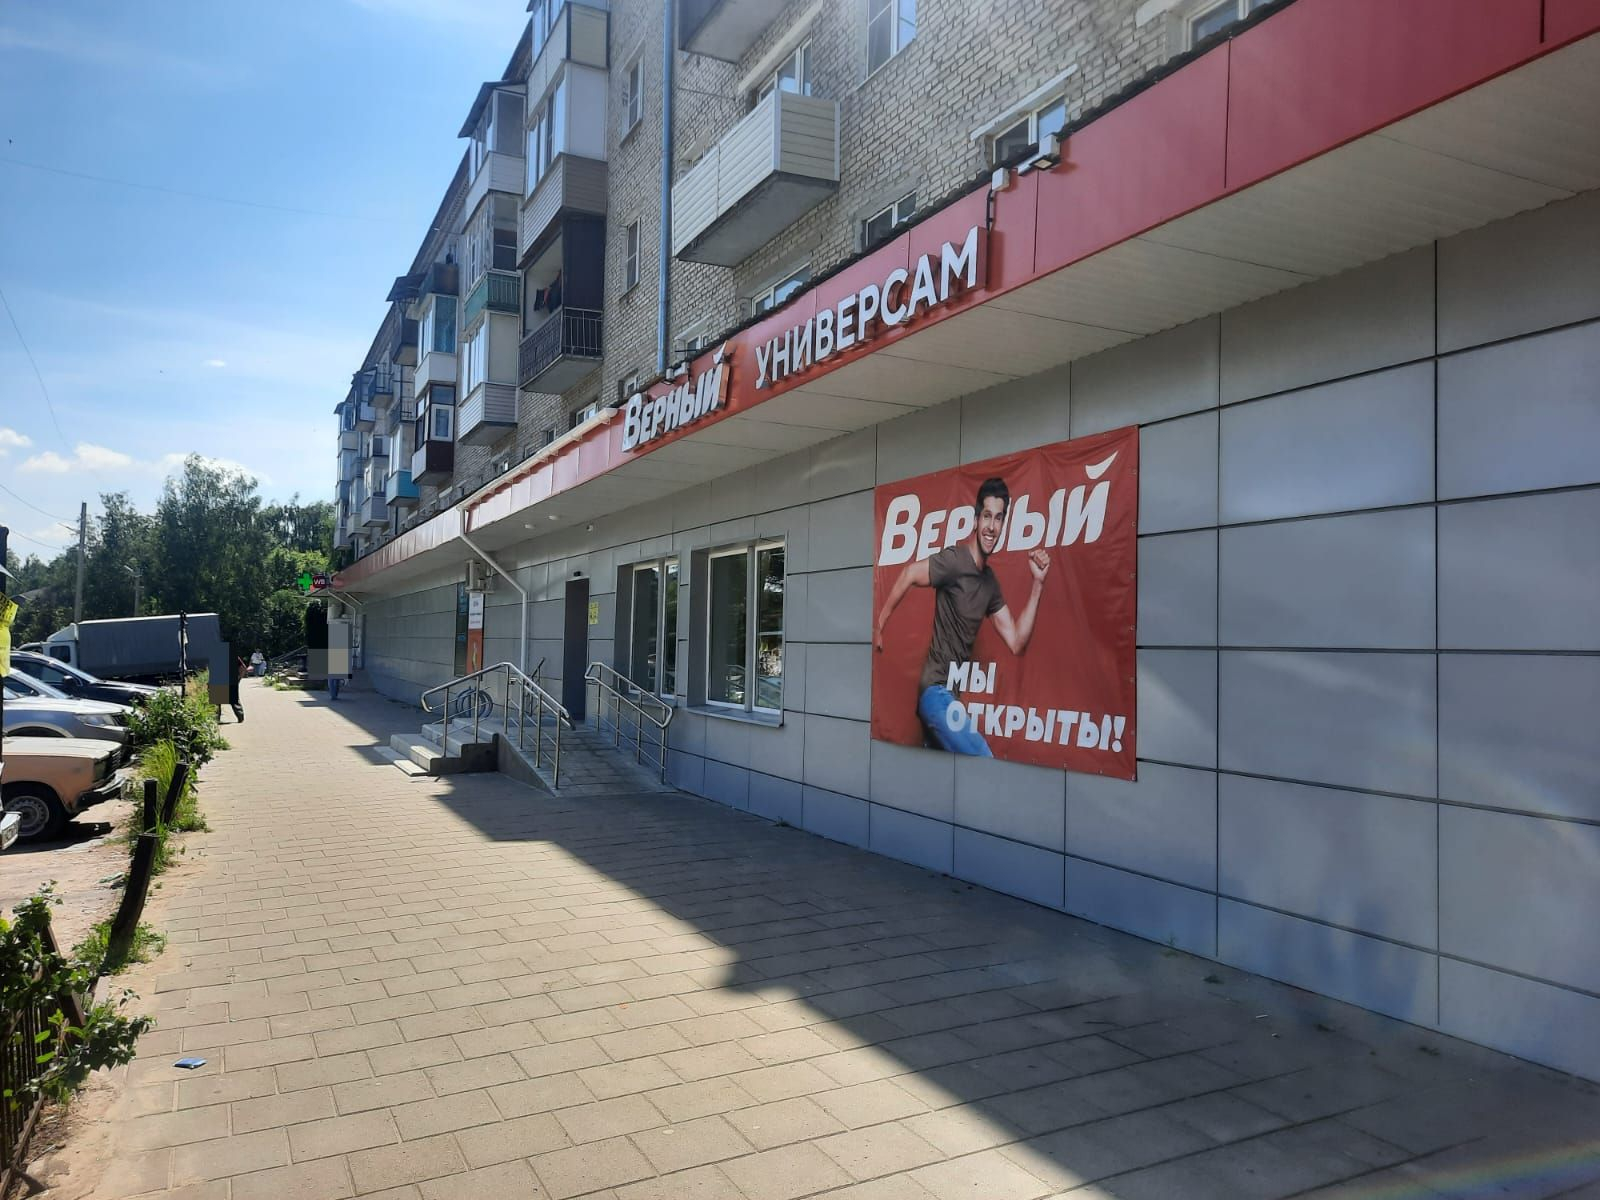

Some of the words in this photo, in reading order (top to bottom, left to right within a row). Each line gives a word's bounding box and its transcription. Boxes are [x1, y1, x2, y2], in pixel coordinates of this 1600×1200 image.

[755, 225, 979, 390] УНИВЕРСАМ
[878, 451, 1118, 567] ВЕРЫЙ
[946, 661, 997, 695] МЫ
[946, 700, 1126, 753] ОТКРЫТЫ!
